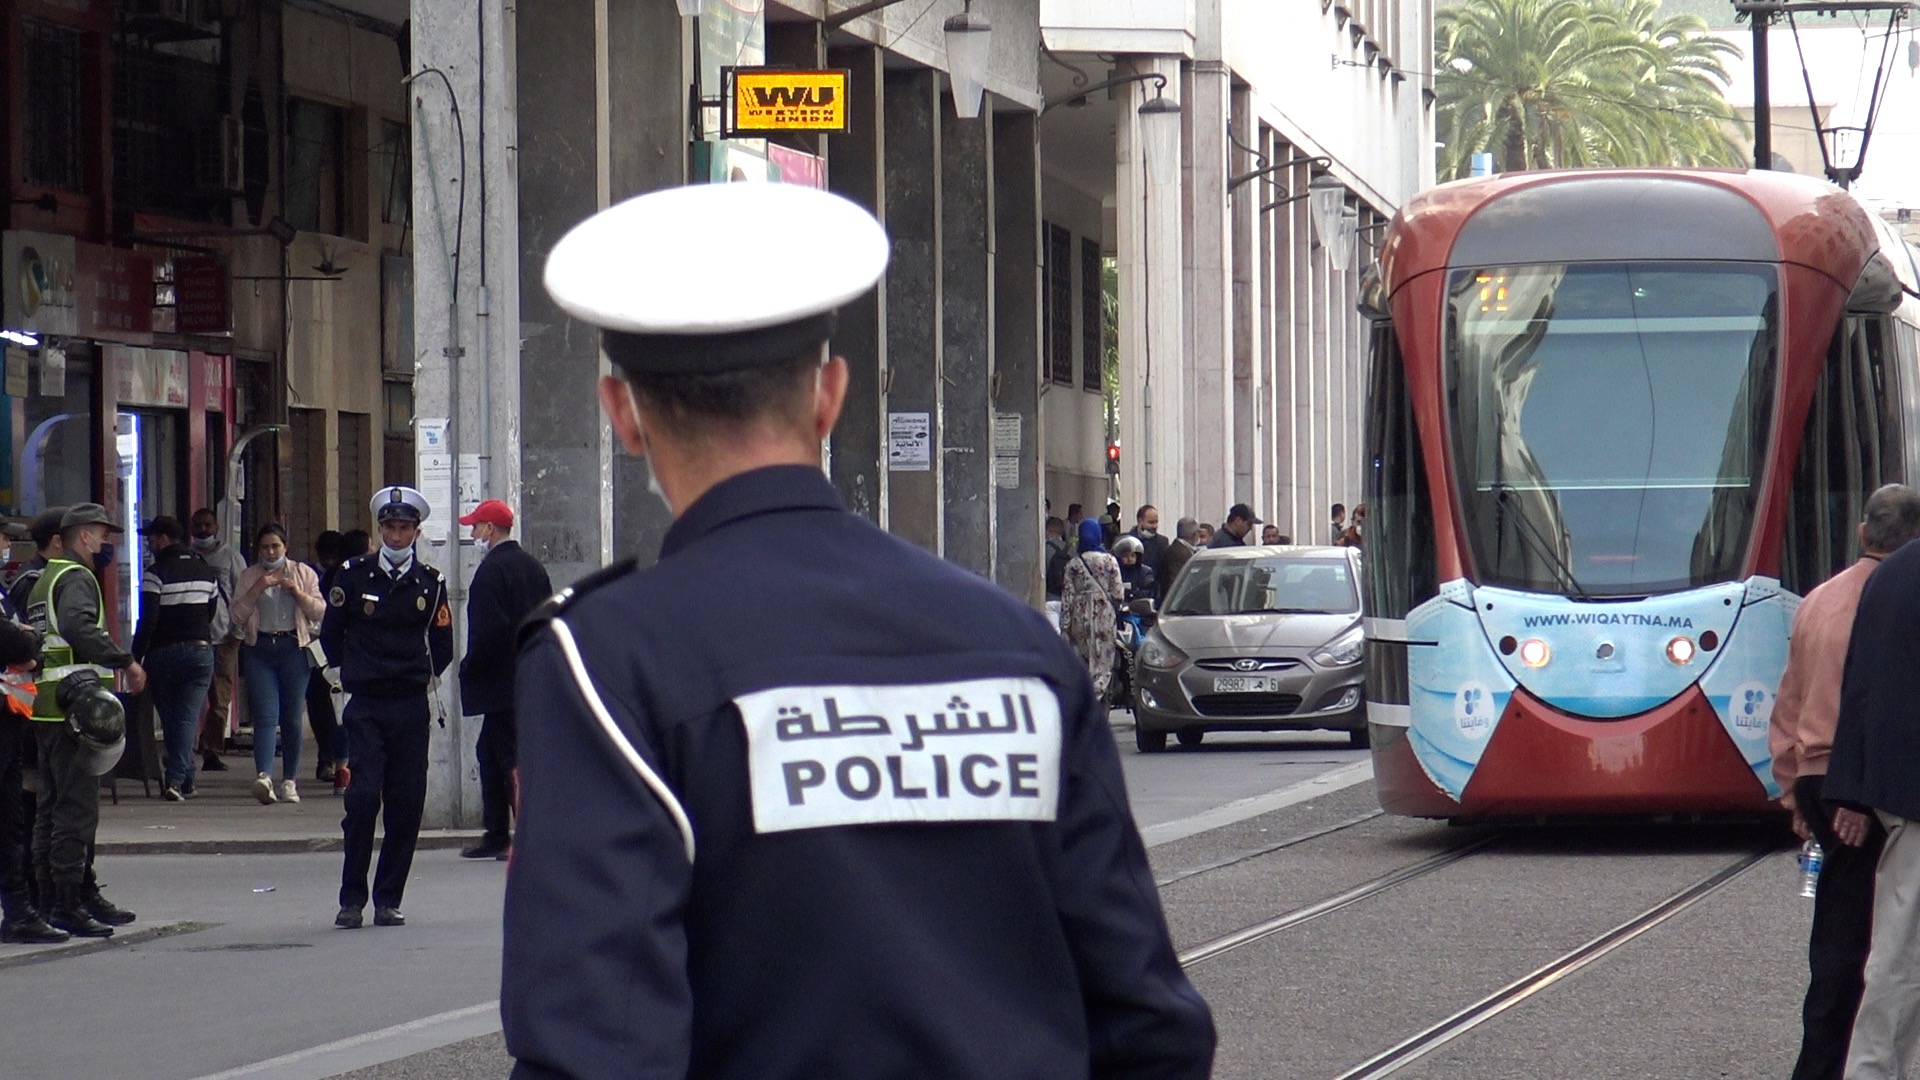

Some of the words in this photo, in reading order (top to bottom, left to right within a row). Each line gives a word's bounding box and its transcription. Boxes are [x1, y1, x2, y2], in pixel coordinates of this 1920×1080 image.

[753, 87, 834, 107] WU
[1524, 613, 1693, 629] WWW.WIQAYTNA.MA
[1216, 678, 1245, 691] 29982
[1270, 678, 1277, 690] 6
[776, 694, 1037, 751] الشرطة
[781, 754, 1039, 806] POLICE
